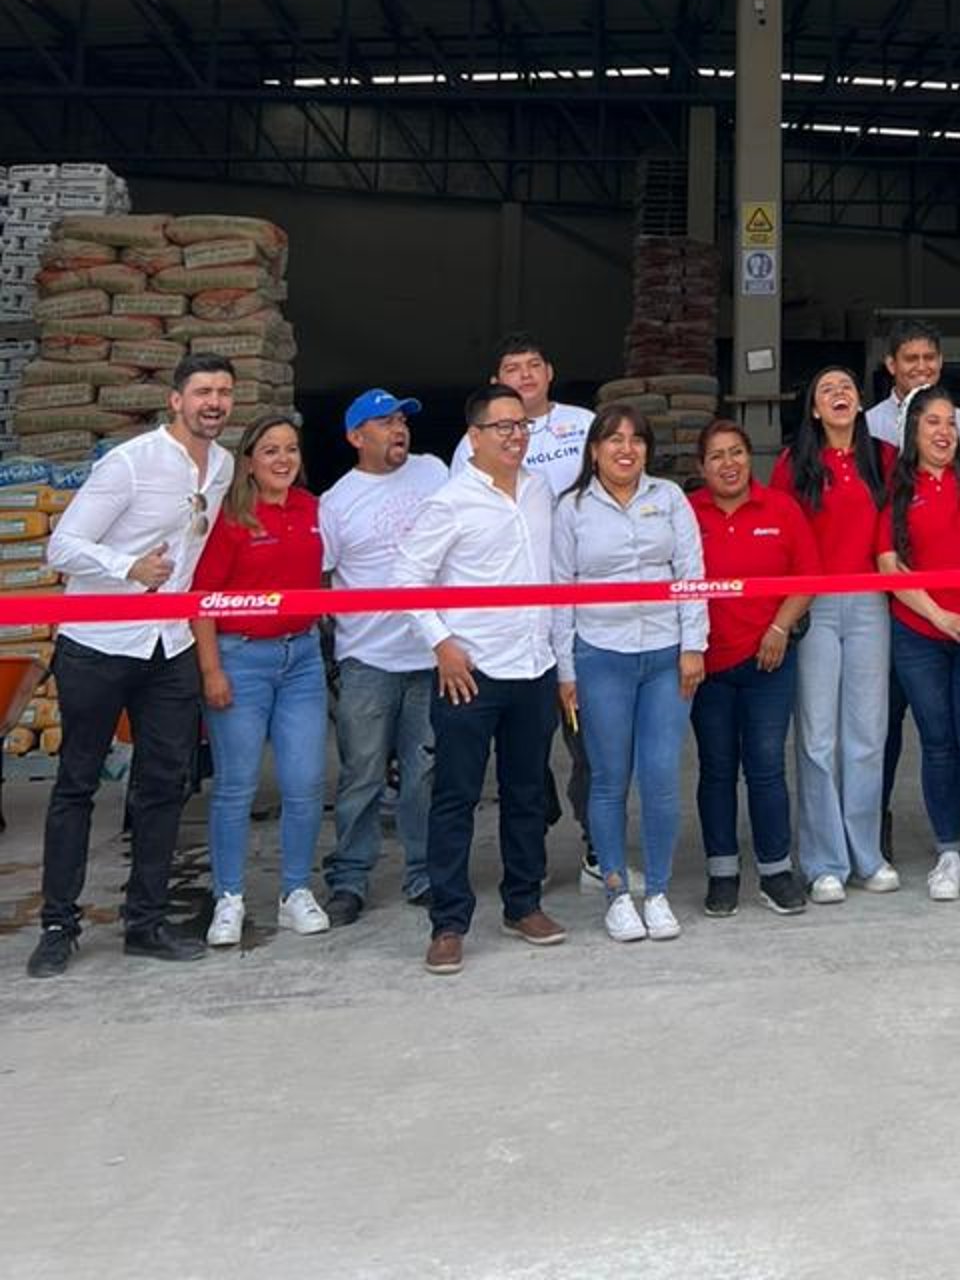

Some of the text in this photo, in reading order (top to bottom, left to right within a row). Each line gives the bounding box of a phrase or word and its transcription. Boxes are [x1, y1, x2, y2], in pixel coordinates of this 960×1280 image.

[527, 446, 580, 466] HOLCIM
[670, 580, 744, 593] disensa
[200, 591, 284, 609] disensa
